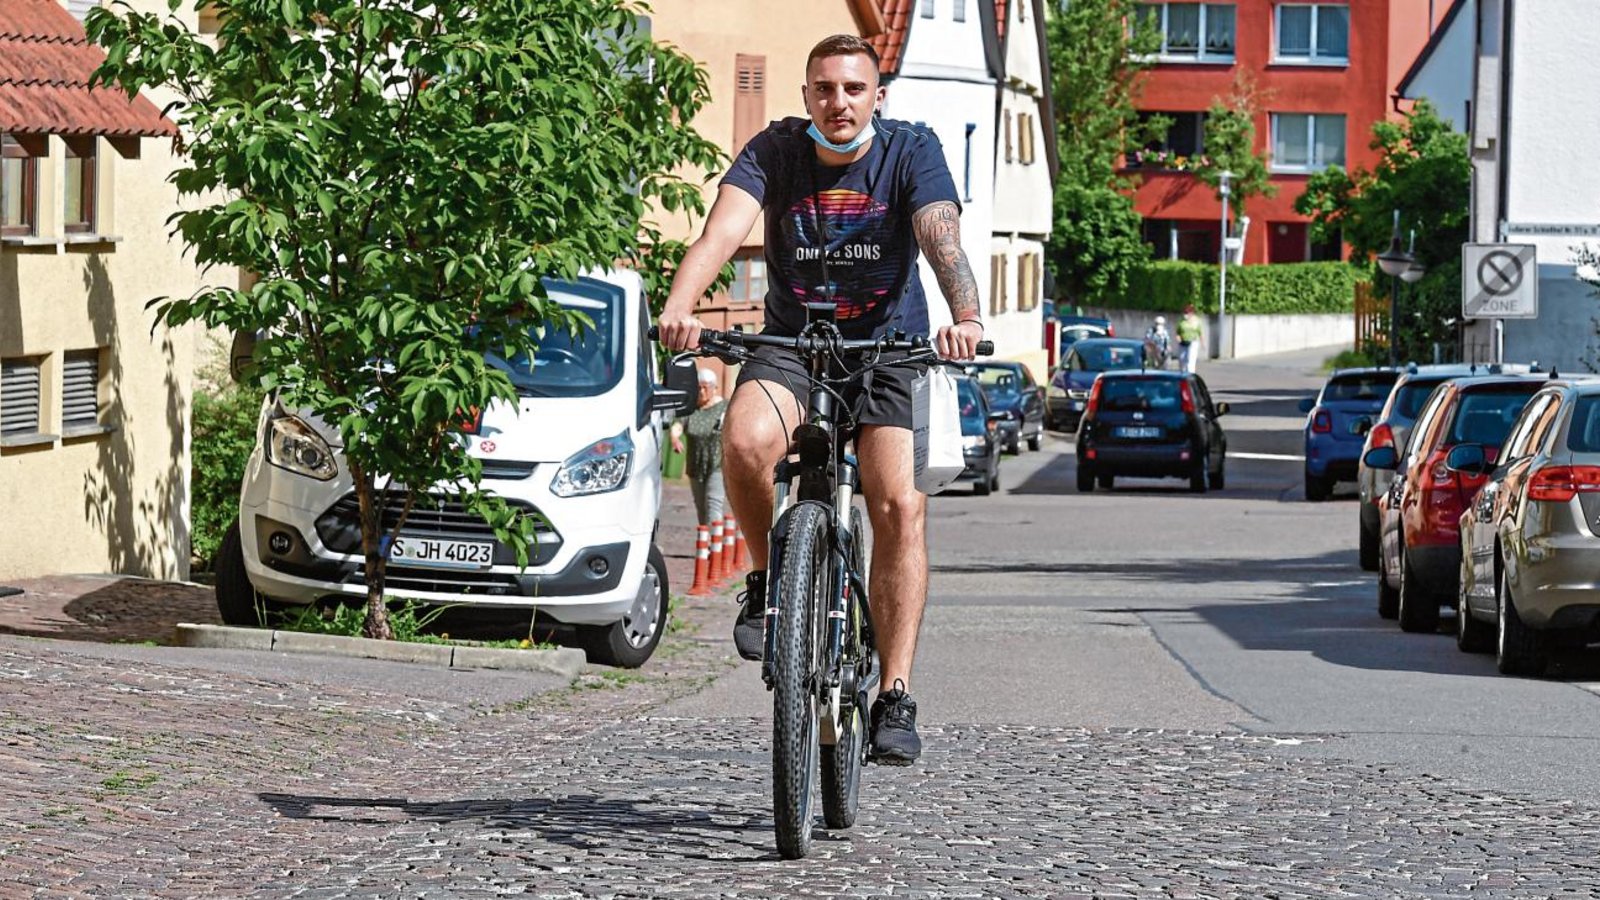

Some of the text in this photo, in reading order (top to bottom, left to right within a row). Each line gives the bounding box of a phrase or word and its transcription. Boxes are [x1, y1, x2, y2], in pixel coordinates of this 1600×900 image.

[844, 244, 881, 260] SONS
[1482, 299, 1518, 312] ZONE
[393, 540, 491, 563] S JH 4023
